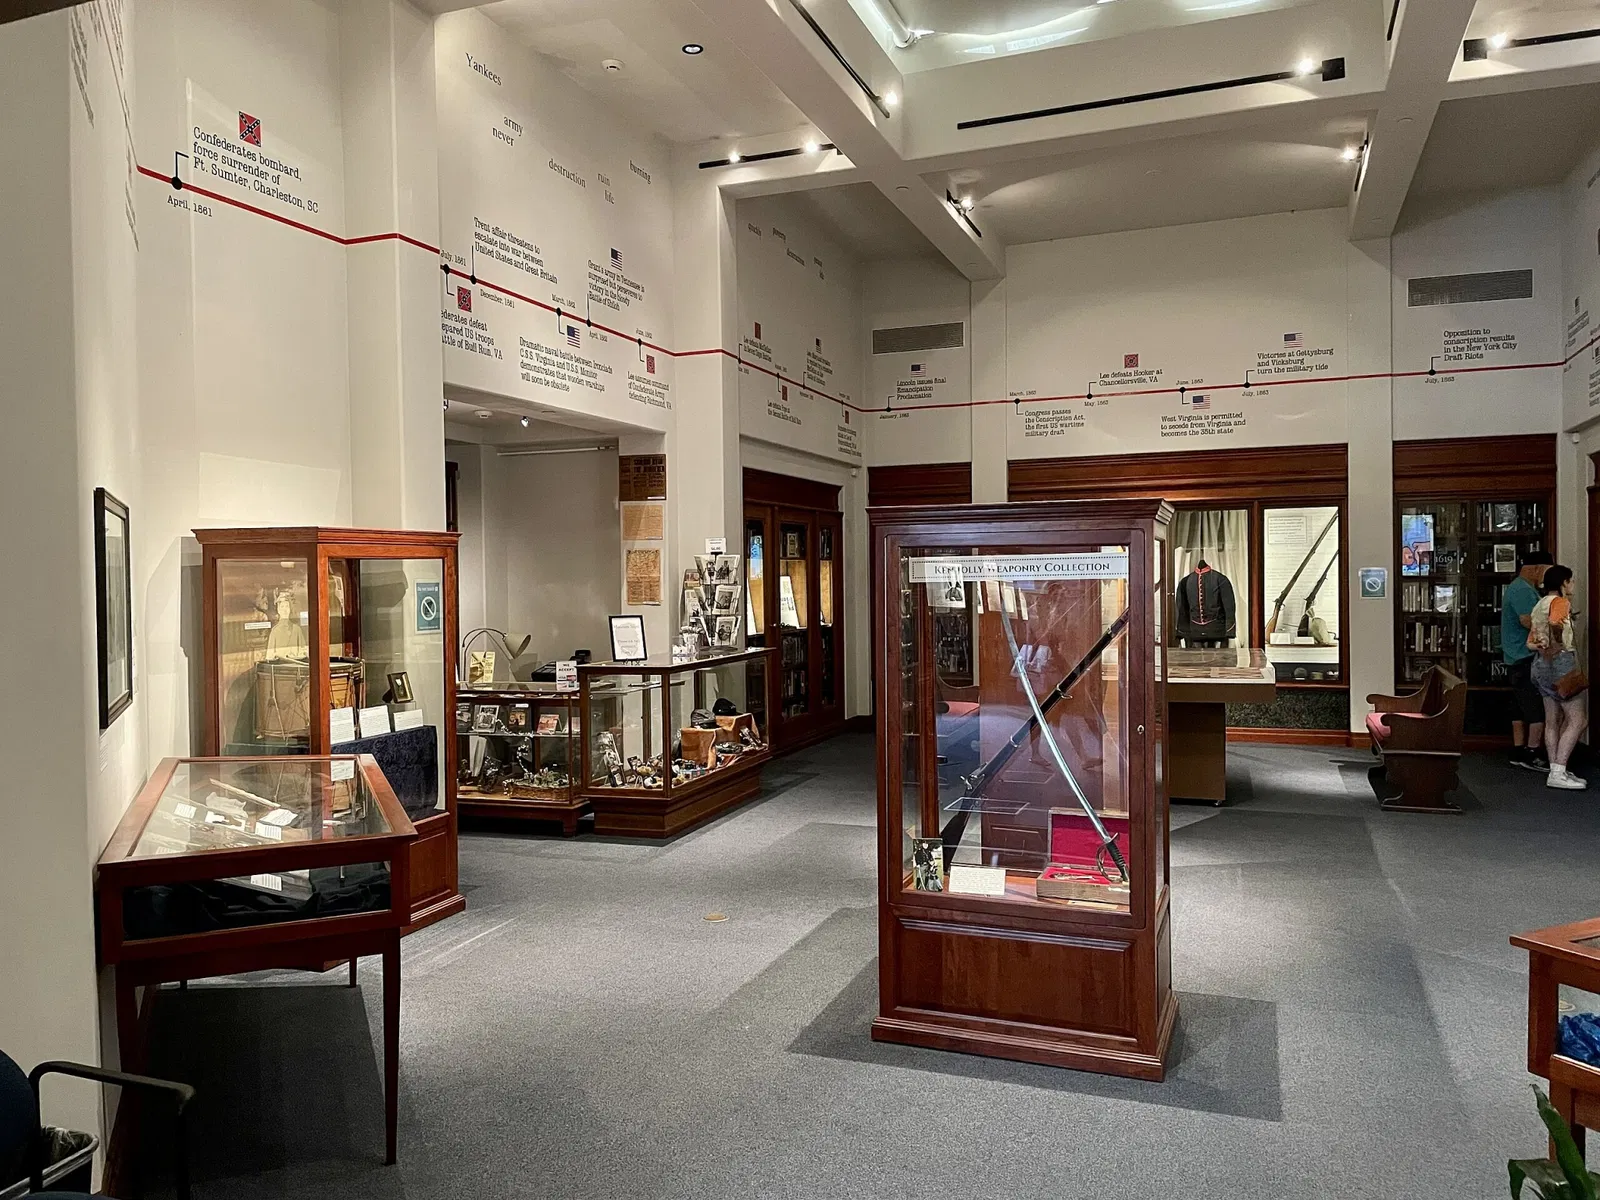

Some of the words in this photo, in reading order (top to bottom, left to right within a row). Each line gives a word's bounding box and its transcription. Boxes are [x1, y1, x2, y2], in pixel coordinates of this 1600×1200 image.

[466, 52, 502, 86] Yankees
[504, 116, 523, 136] army
[492, 127, 514, 146] never
[194, 127, 257, 162] Confederates
[259, 152, 302, 181] bombard,
[194, 142, 218, 161] force
[221, 155, 269, 180] surrender
[271, 174, 281, 185] of
[549, 158, 585, 188] destruction
[630, 160, 651, 184] burning
[194, 157, 208, 172] Ft.
[211, 166, 251, 190] Sumter,
[254, 180, 305, 210] Charleston,
[307, 200, 318, 213] SC
[167, 195, 190, 211] April,
[193, 203, 212, 217] 1861
[474, 217, 490, 232] Trent
[508, 232, 533, 252] threatens
[535, 244, 540, 254] to
[475, 231, 497, 247] escalate
[499, 241, 510, 252] into
[523, 250, 543, 267] between
[475, 242, 494, 258] United
[495, 251, 512, 266] States
[514, 259, 524, 270] and
[525, 263, 539, 276] Great
[540, 268, 557, 284] Britain
[441, 309, 467, 325] ederates
[469, 318, 487, 331] defeat
[442, 323, 463, 336] epared
[465, 328, 473, 339] US
[475, 332, 494, 346] troops
[1444, 330, 1481, 338] Opposition
[457, 339, 463, 348] of
[465, 340, 477, 352] Bull
[494, 349, 503, 360] VA
[520, 337, 544, 352] Dramatic
[1296, 349, 1333, 357] Gettysburg
[1271, 358, 1304, 367] Vicksburg
[1287, 365, 1314, 374] military
[521, 373, 530, 382] will
[532, 376, 543, 385] soon
[544, 378, 550, 386] be
[1025, 409, 1050, 417] Congress
[1036, 415, 1072, 423] Conscription
[1178, 414, 1202, 423] Virginia
[1211, 412, 1242, 421] permitted
[1207, 420, 1232, 429] Virginia
[1044, 563, 1110, 571] COLLECTION
